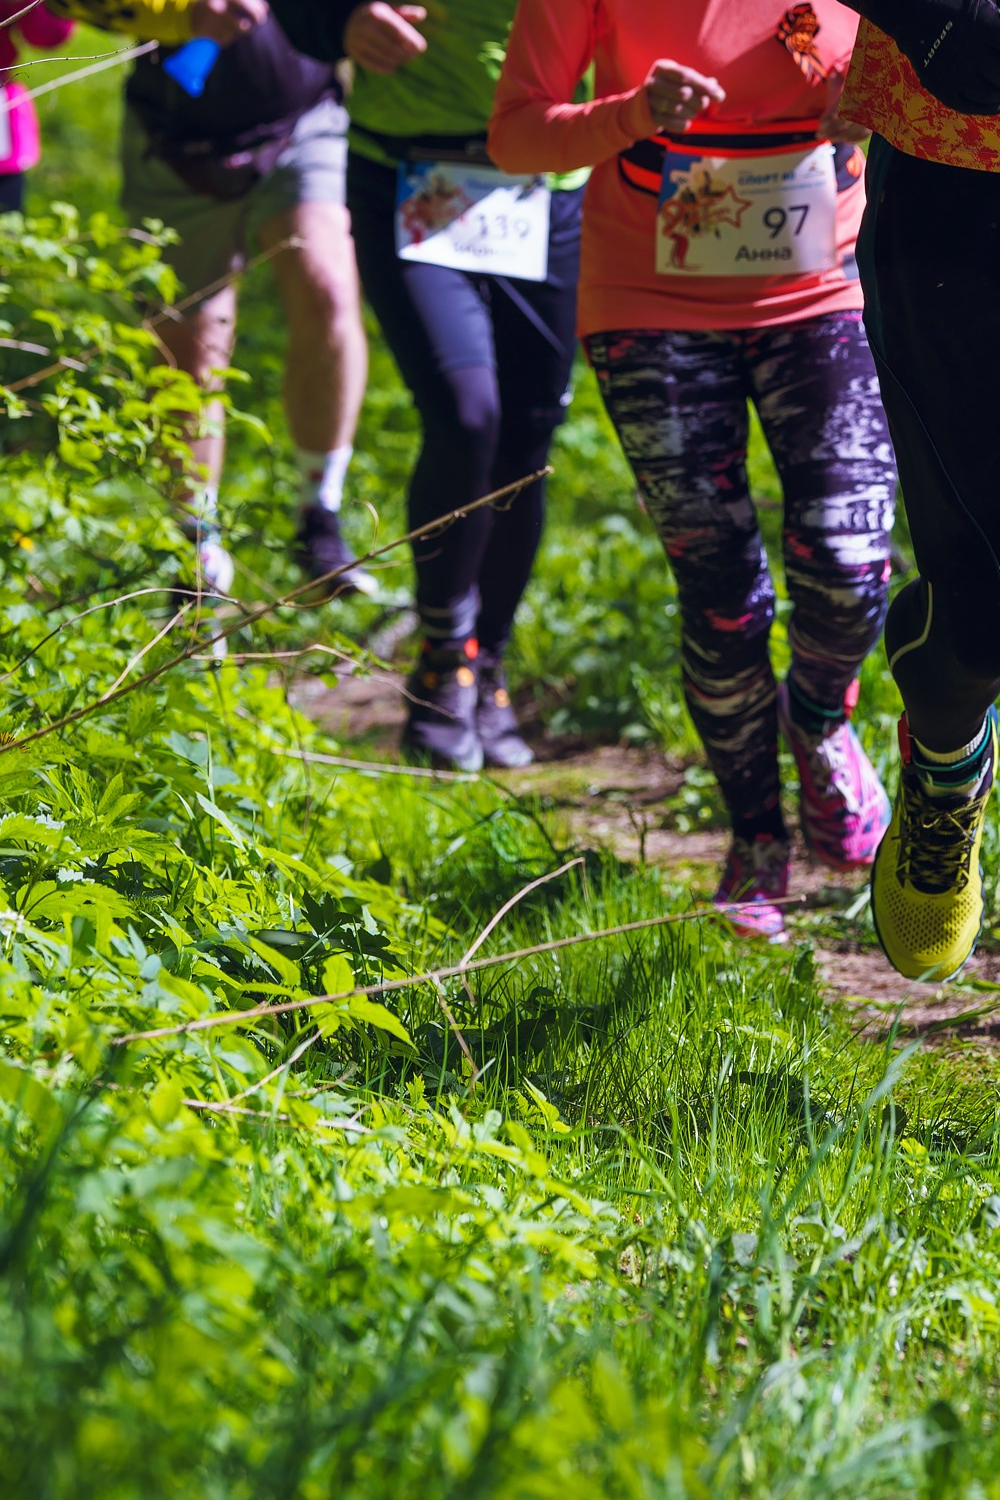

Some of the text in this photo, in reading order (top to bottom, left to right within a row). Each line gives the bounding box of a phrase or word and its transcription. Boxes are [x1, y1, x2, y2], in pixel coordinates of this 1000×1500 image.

[479, 214, 531, 242] 139
[763, 205, 810, 240] 97
[735, 245, 793, 263] Анна
